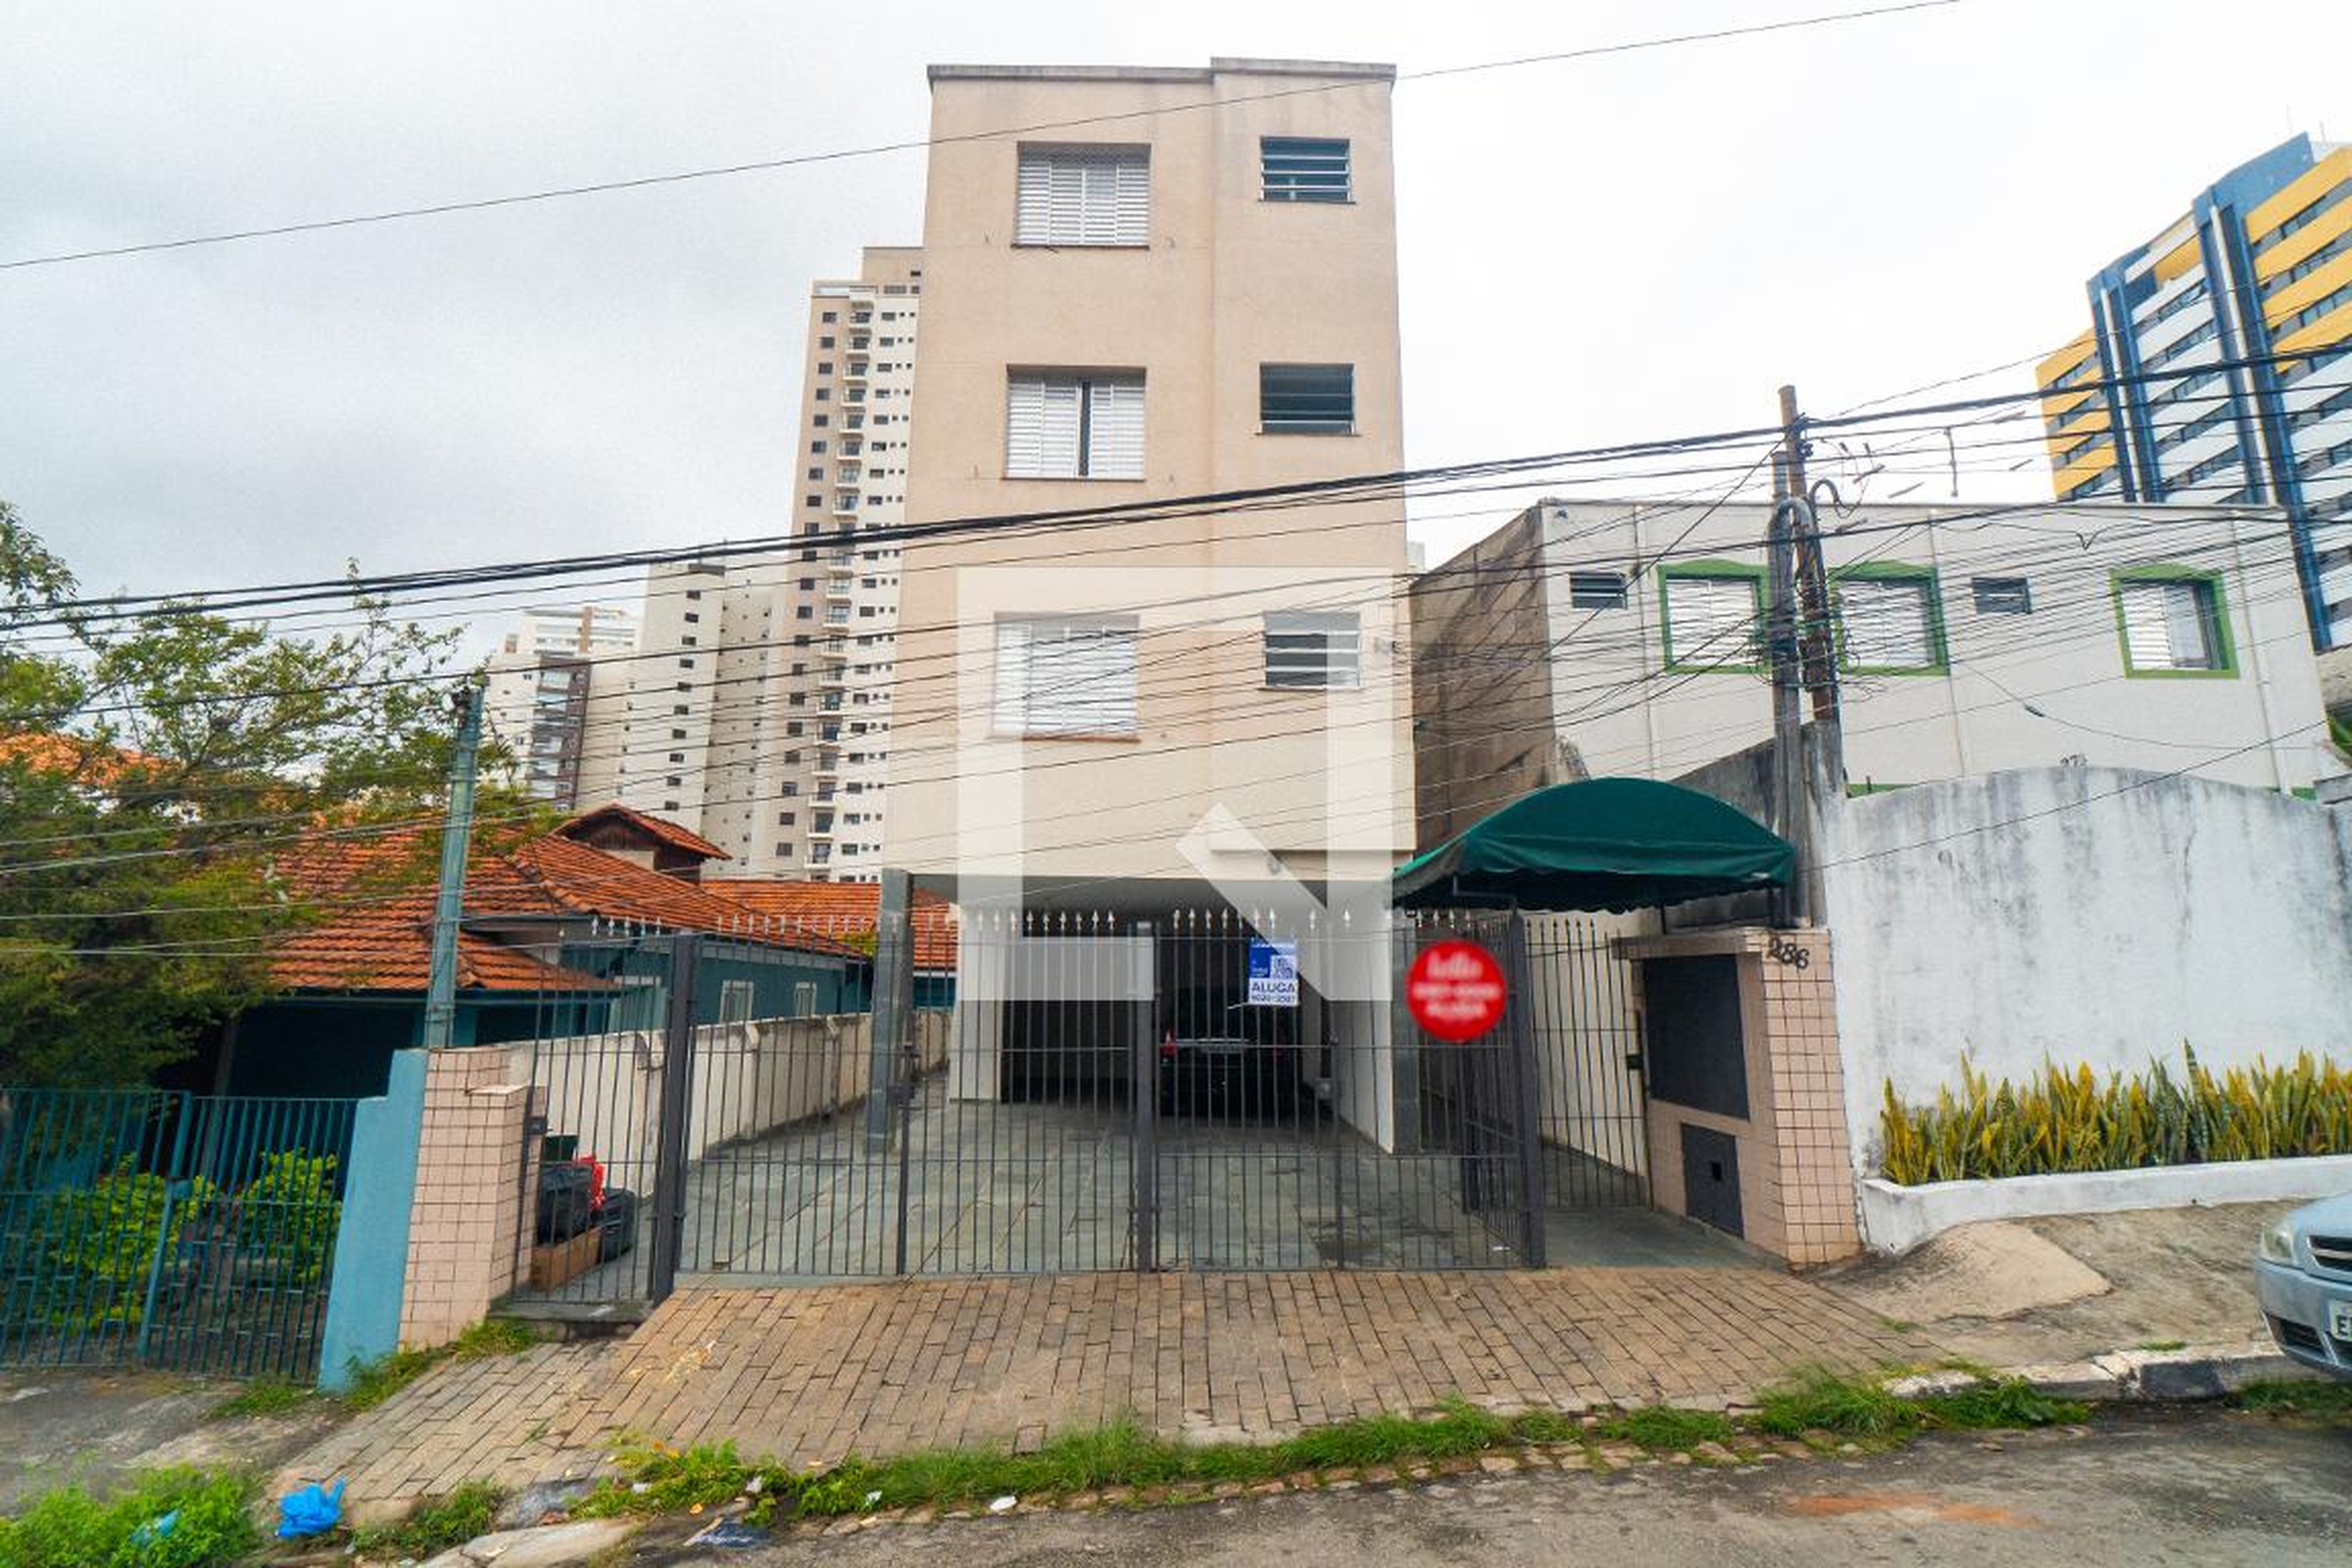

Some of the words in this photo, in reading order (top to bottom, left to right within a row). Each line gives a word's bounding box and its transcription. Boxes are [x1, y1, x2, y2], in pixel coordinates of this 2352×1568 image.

[1767, 937, 1809, 969] 286
[1252, 982, 1295, 992] ALUGA
[2335, 1315, 2352, 1336] E
